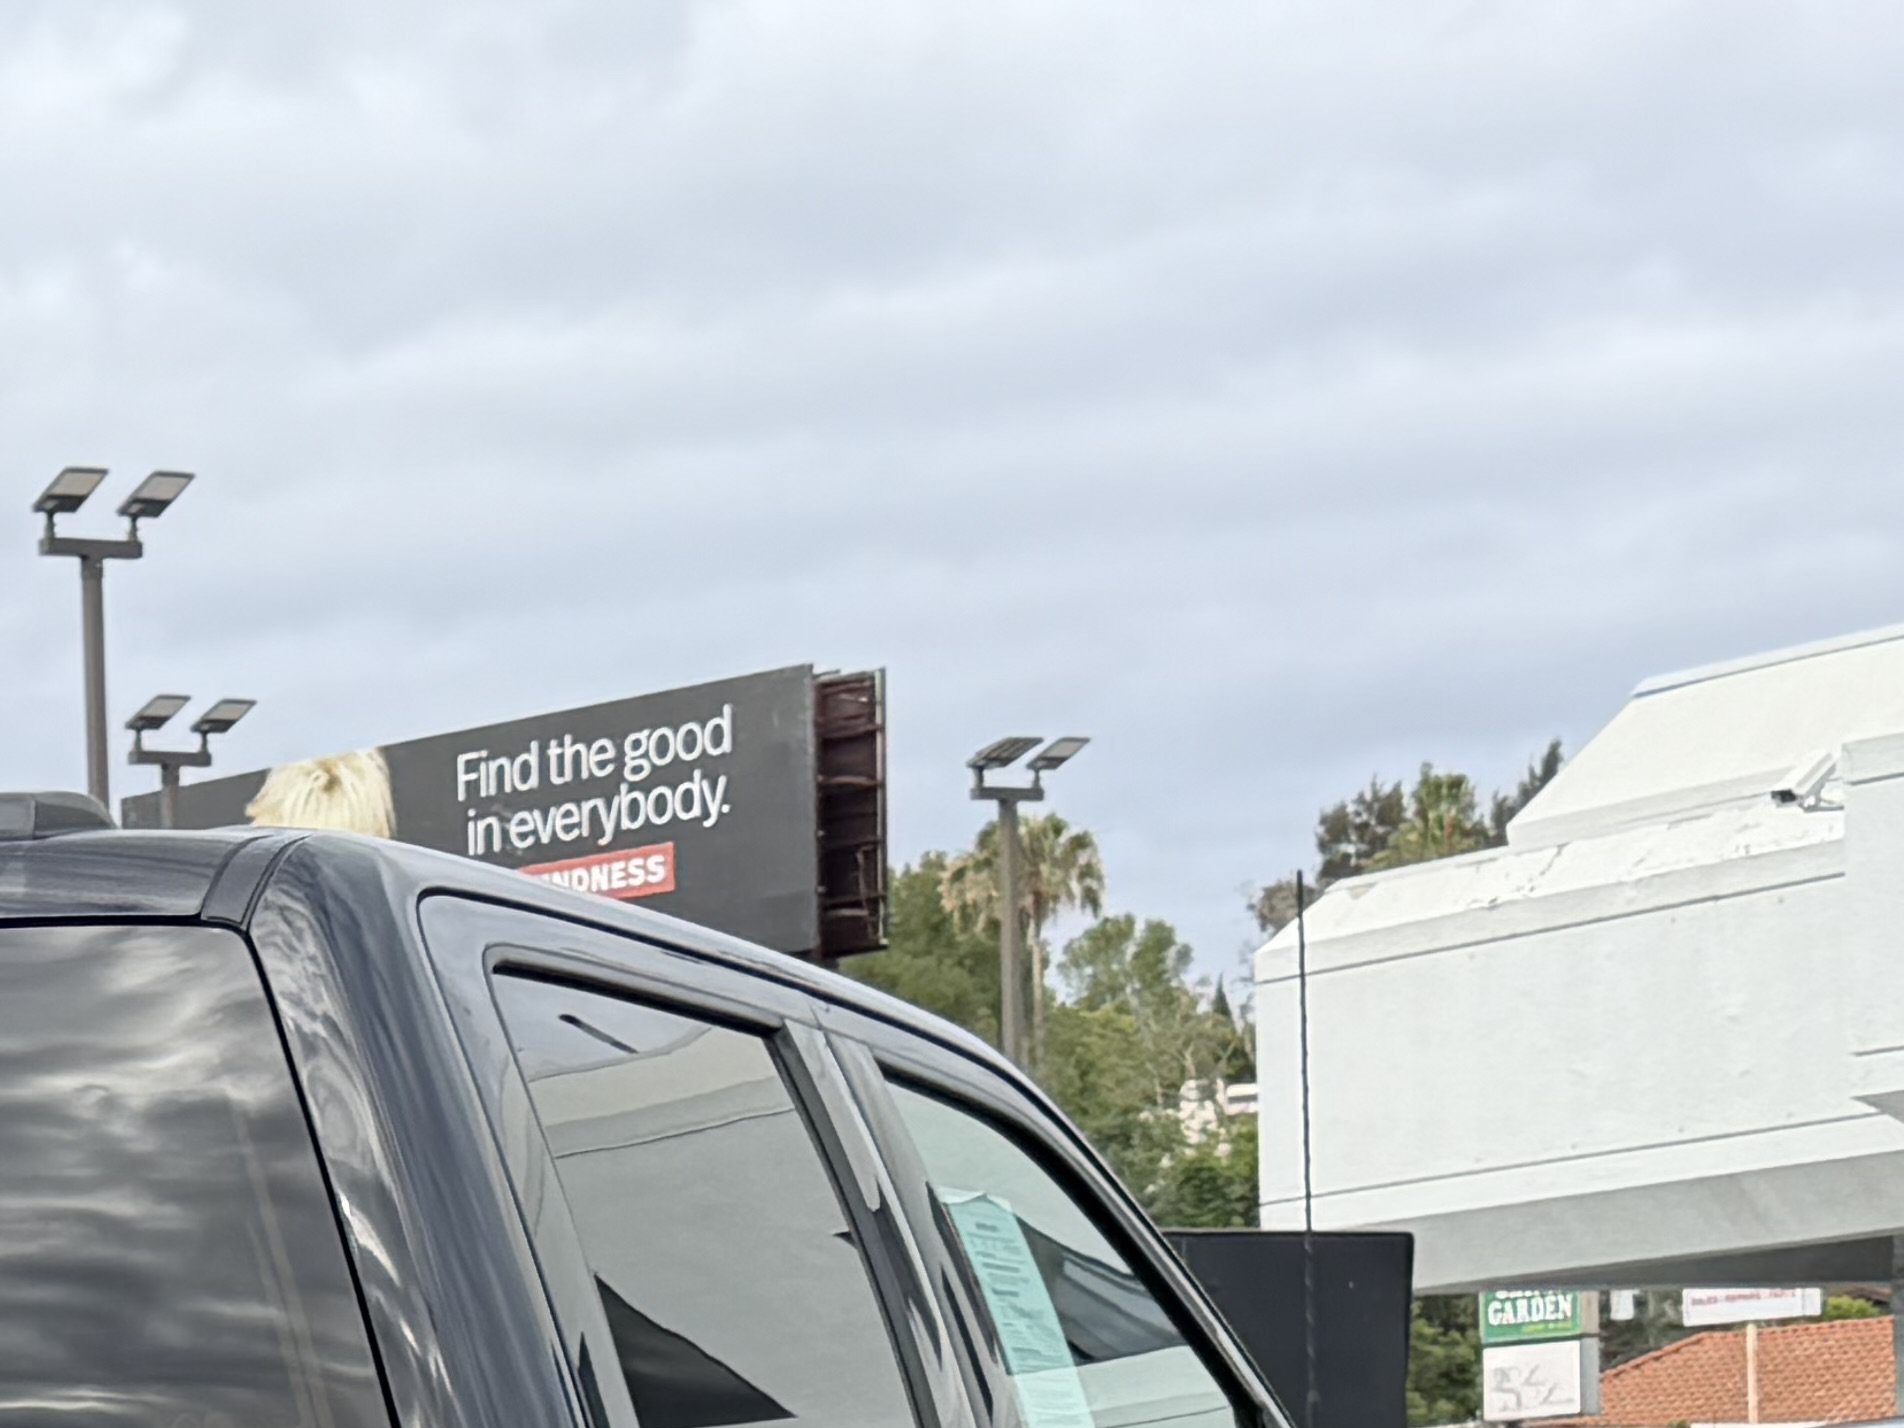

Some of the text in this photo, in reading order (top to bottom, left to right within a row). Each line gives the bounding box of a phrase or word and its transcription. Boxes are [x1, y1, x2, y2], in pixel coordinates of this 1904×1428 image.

[456, 703, 733, 802] Find the good
[467, 768, 732, 856] in everybody.
[541, 853, 667, 892] NDNESS
